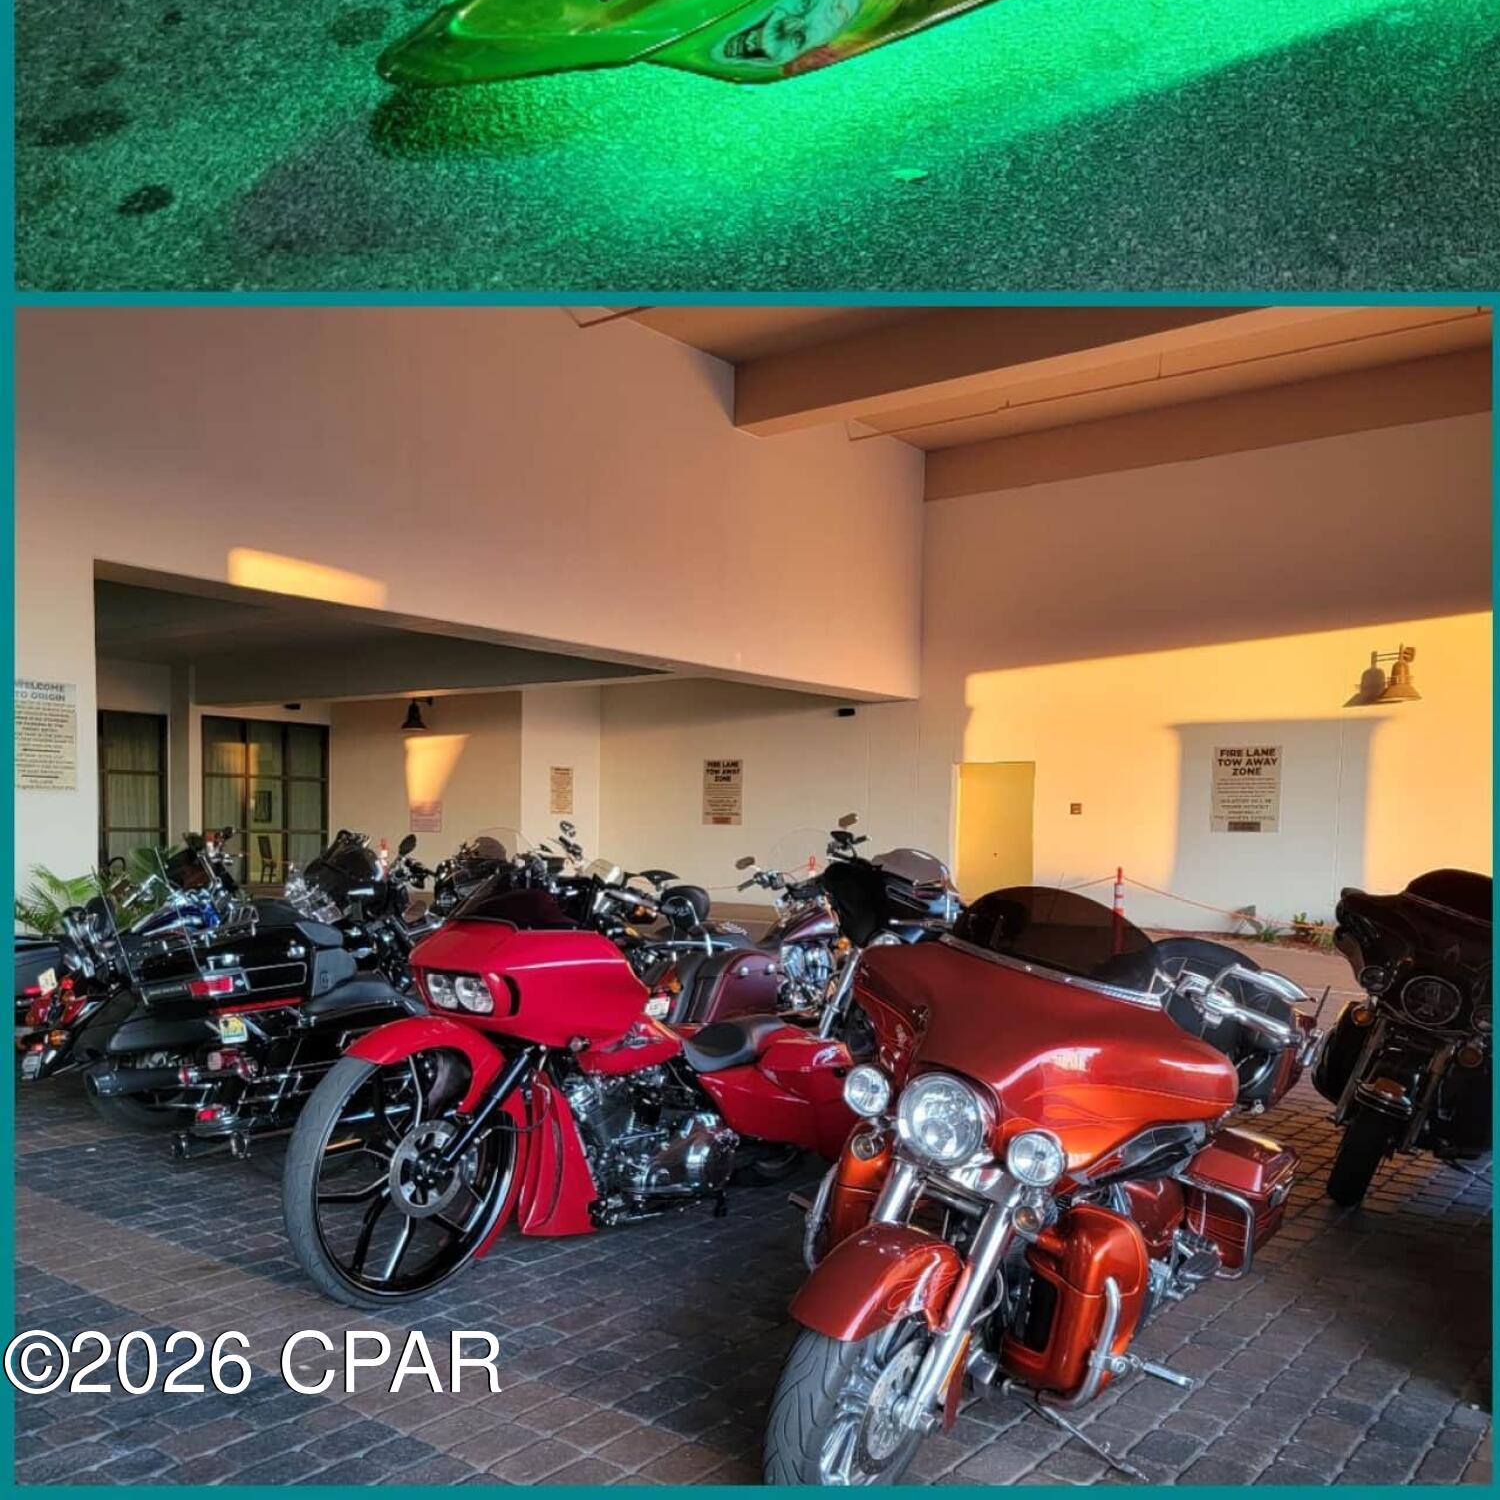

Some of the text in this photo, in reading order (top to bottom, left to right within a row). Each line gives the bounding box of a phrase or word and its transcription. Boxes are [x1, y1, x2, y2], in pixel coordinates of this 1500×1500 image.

[1220, 748, 1276, 757] FIRE LANE
[1217, 758, 1278, 767] TOW AWAY
[1232, 767, 1262, 776] ZONE
